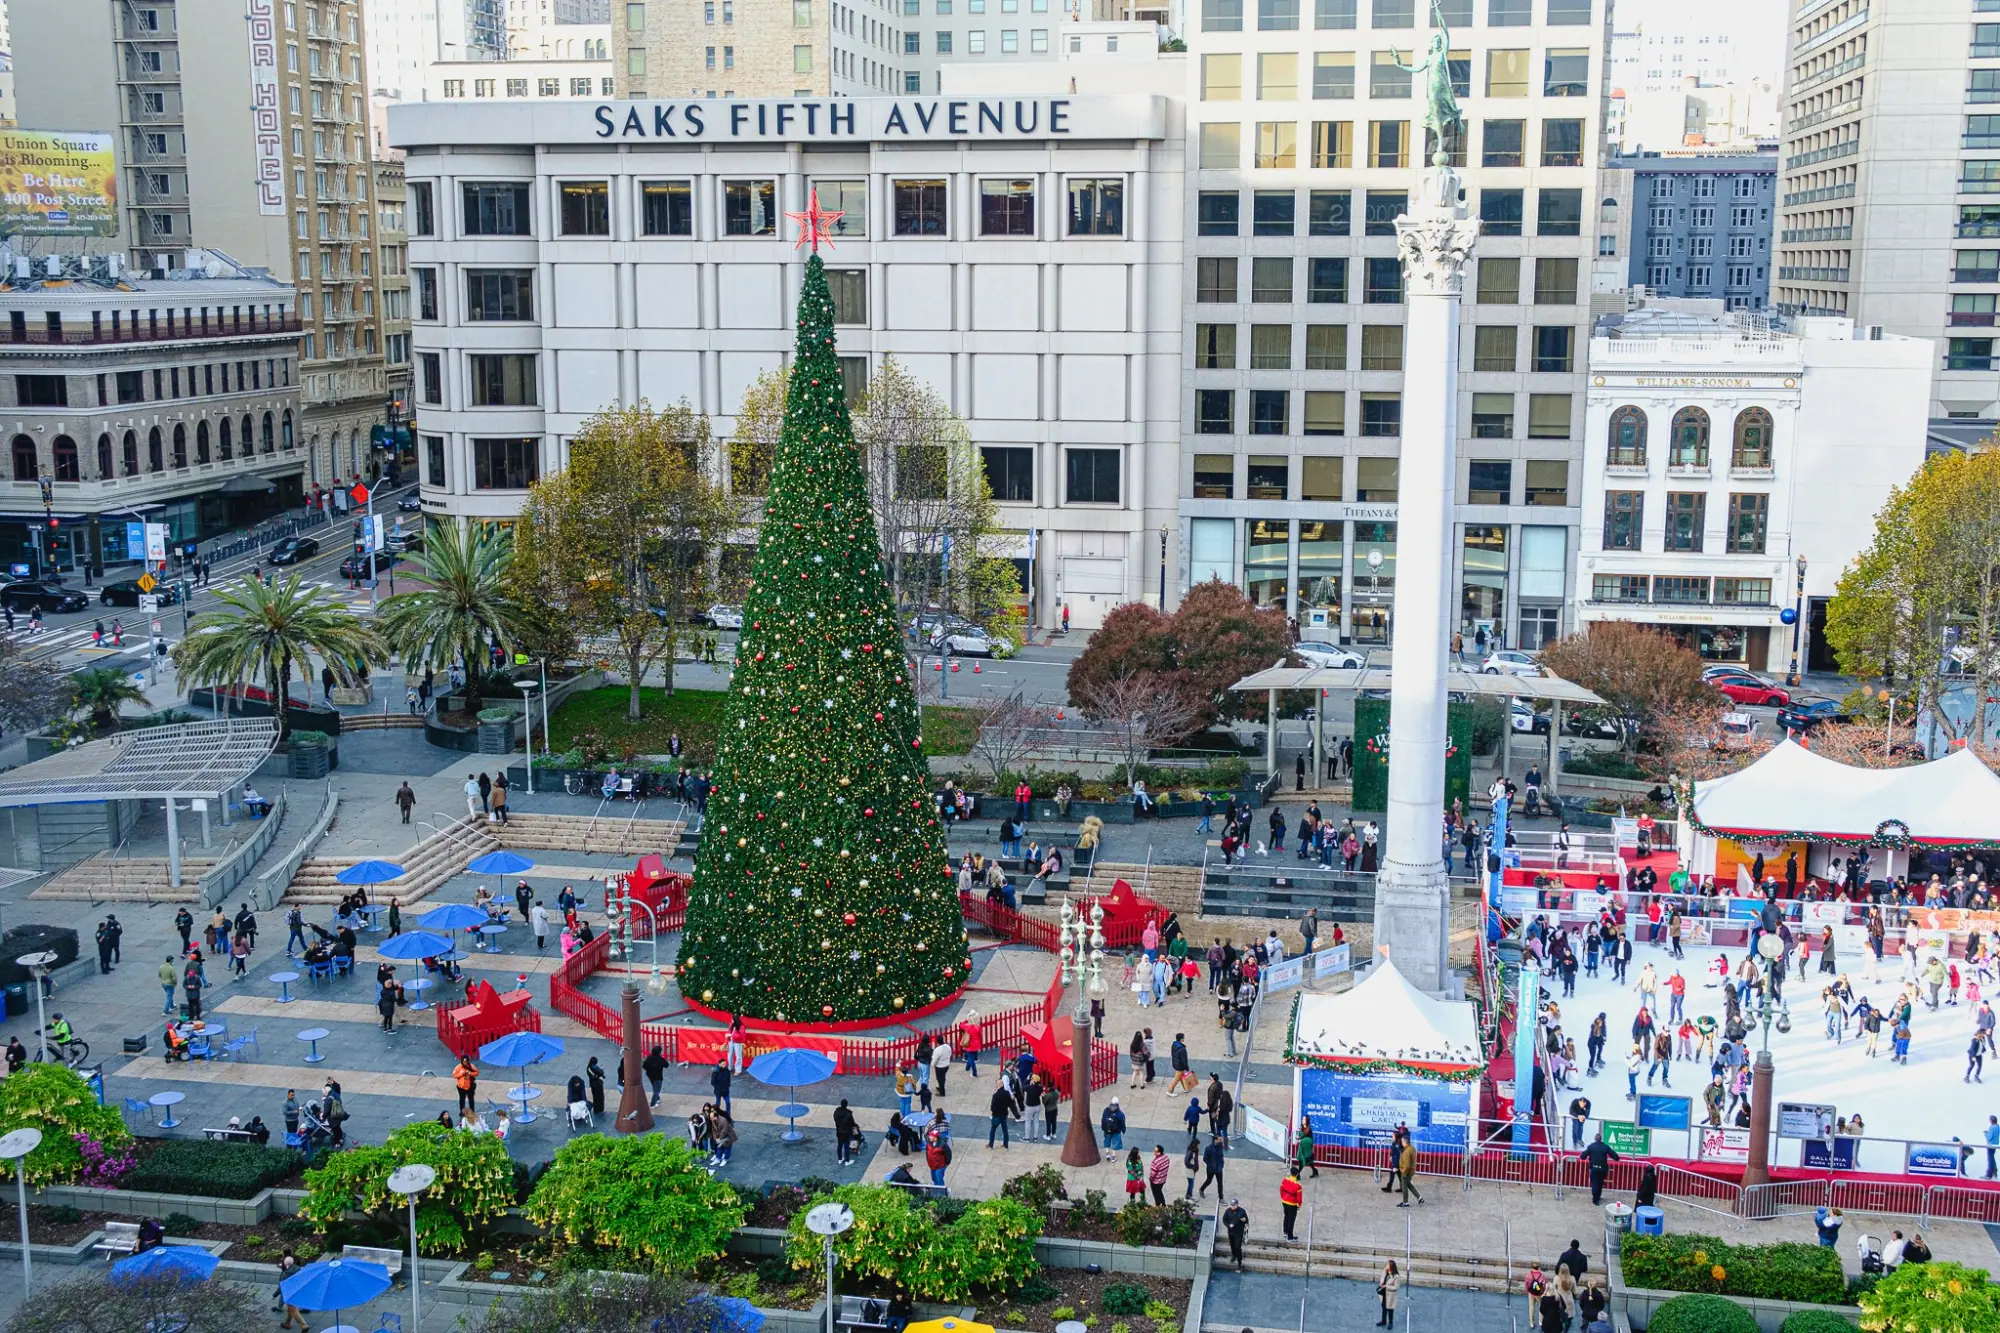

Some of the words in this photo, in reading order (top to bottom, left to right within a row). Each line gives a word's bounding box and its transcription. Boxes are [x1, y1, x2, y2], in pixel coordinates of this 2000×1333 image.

[595, 104, 705, 138] SAKS
[731, 102, 855, 136] FIFTH
[884, 99, 1072, 134] AVENUE
[4, 137, 48, 150] Union
[52, 138, 99, 154] Square
[256, 83, 282, 206] HOTEL
[4, 153, 17, 166] is
[21, 154, 101, 171] Blooming...
[23, 173, 45, 188] Be
[47, 173, 87, 188] Here
[4, 192, 31, 205] 400
[35, 192, 63, 206] Post
[67, 193, 108, 206] Street
[1636, 377, 1752, 388] WILLIAMS-SONOMA
[1360, 1110, 1407, 1118] CHRISTMAS
